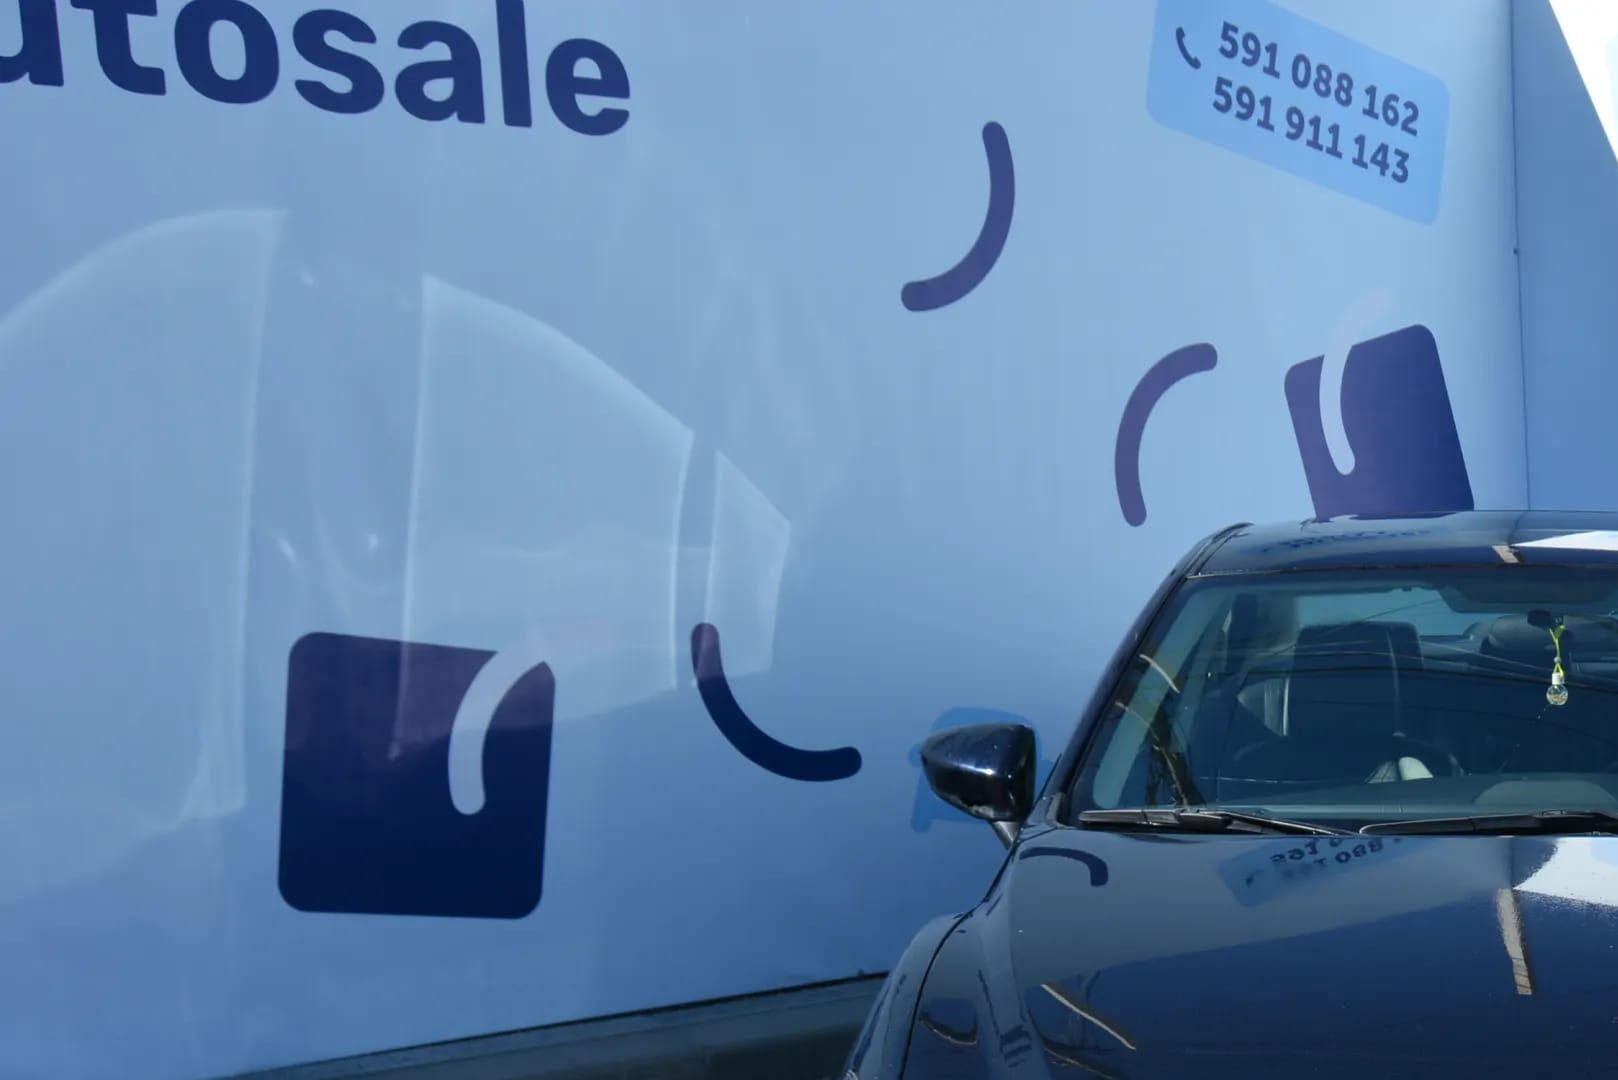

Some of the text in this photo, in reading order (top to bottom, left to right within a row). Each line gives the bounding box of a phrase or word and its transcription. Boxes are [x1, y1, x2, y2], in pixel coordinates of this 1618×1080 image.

[1213, 76, 1410, 183] 591 911 143
[1219, 21, 1419, 136] 591 088 162
